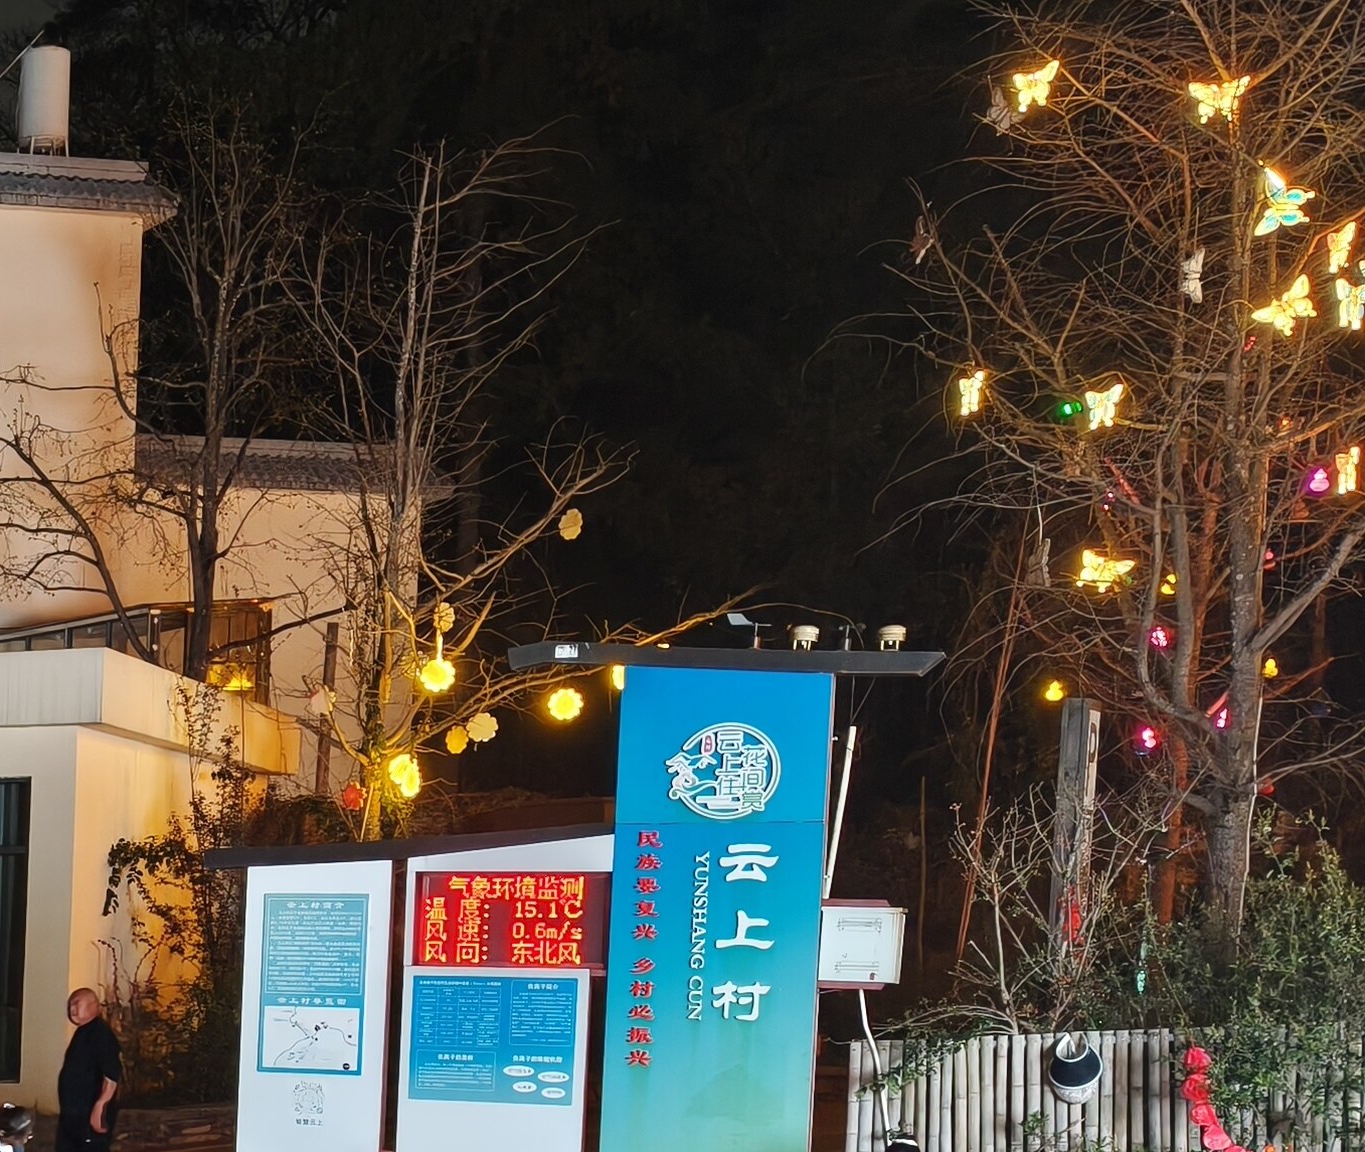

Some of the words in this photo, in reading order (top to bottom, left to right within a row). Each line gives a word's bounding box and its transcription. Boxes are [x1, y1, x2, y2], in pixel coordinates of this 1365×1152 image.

[448, 876, 584, 900] 气象环境监测
[632, 831, 663, 941] 民族要复兴
[691, 851, 710, 969] YUNSHANG
[511, 940, 581, 965] 东北风
[512, 921, 582, 940] 0.6m/s
[712, 843, 779, 1022] 云上村
[625, 957, 656, 1067] 乡村必振兴
[687, 975, 704, 1021] CUN
